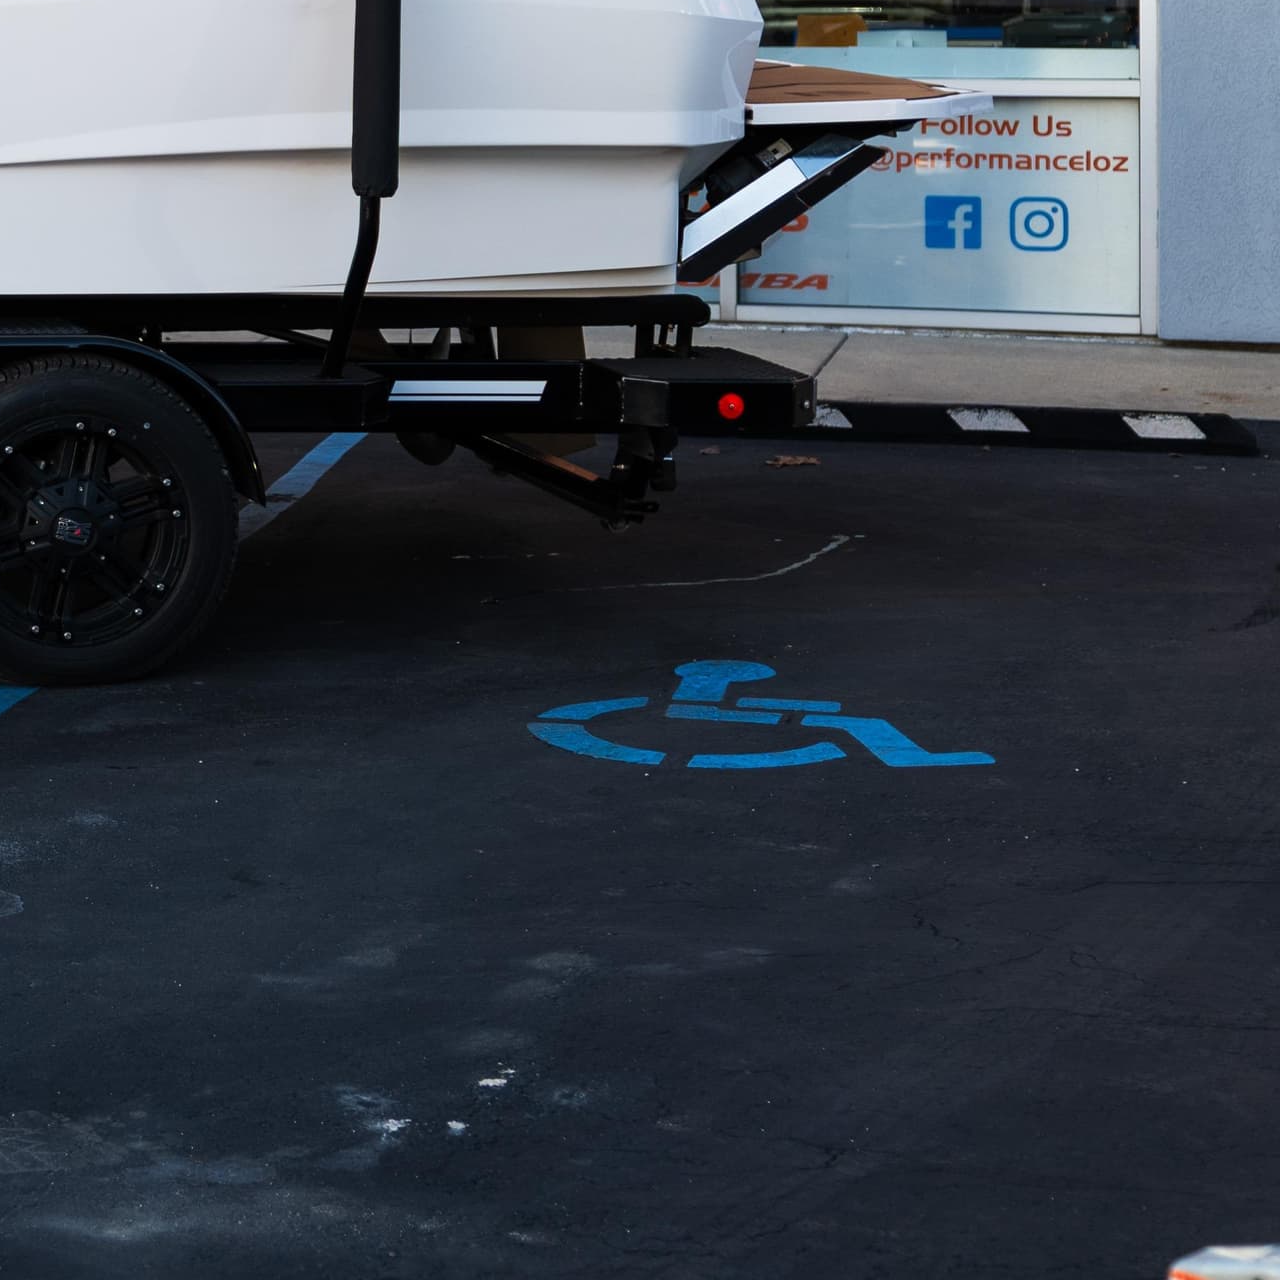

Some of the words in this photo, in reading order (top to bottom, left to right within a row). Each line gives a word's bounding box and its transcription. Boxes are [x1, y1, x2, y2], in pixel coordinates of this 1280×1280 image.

[920, 115, 1020, 137] Follow
[1032, 114, 1072, 137] Us
[870, 146, 1129, 173] @performanceloz
